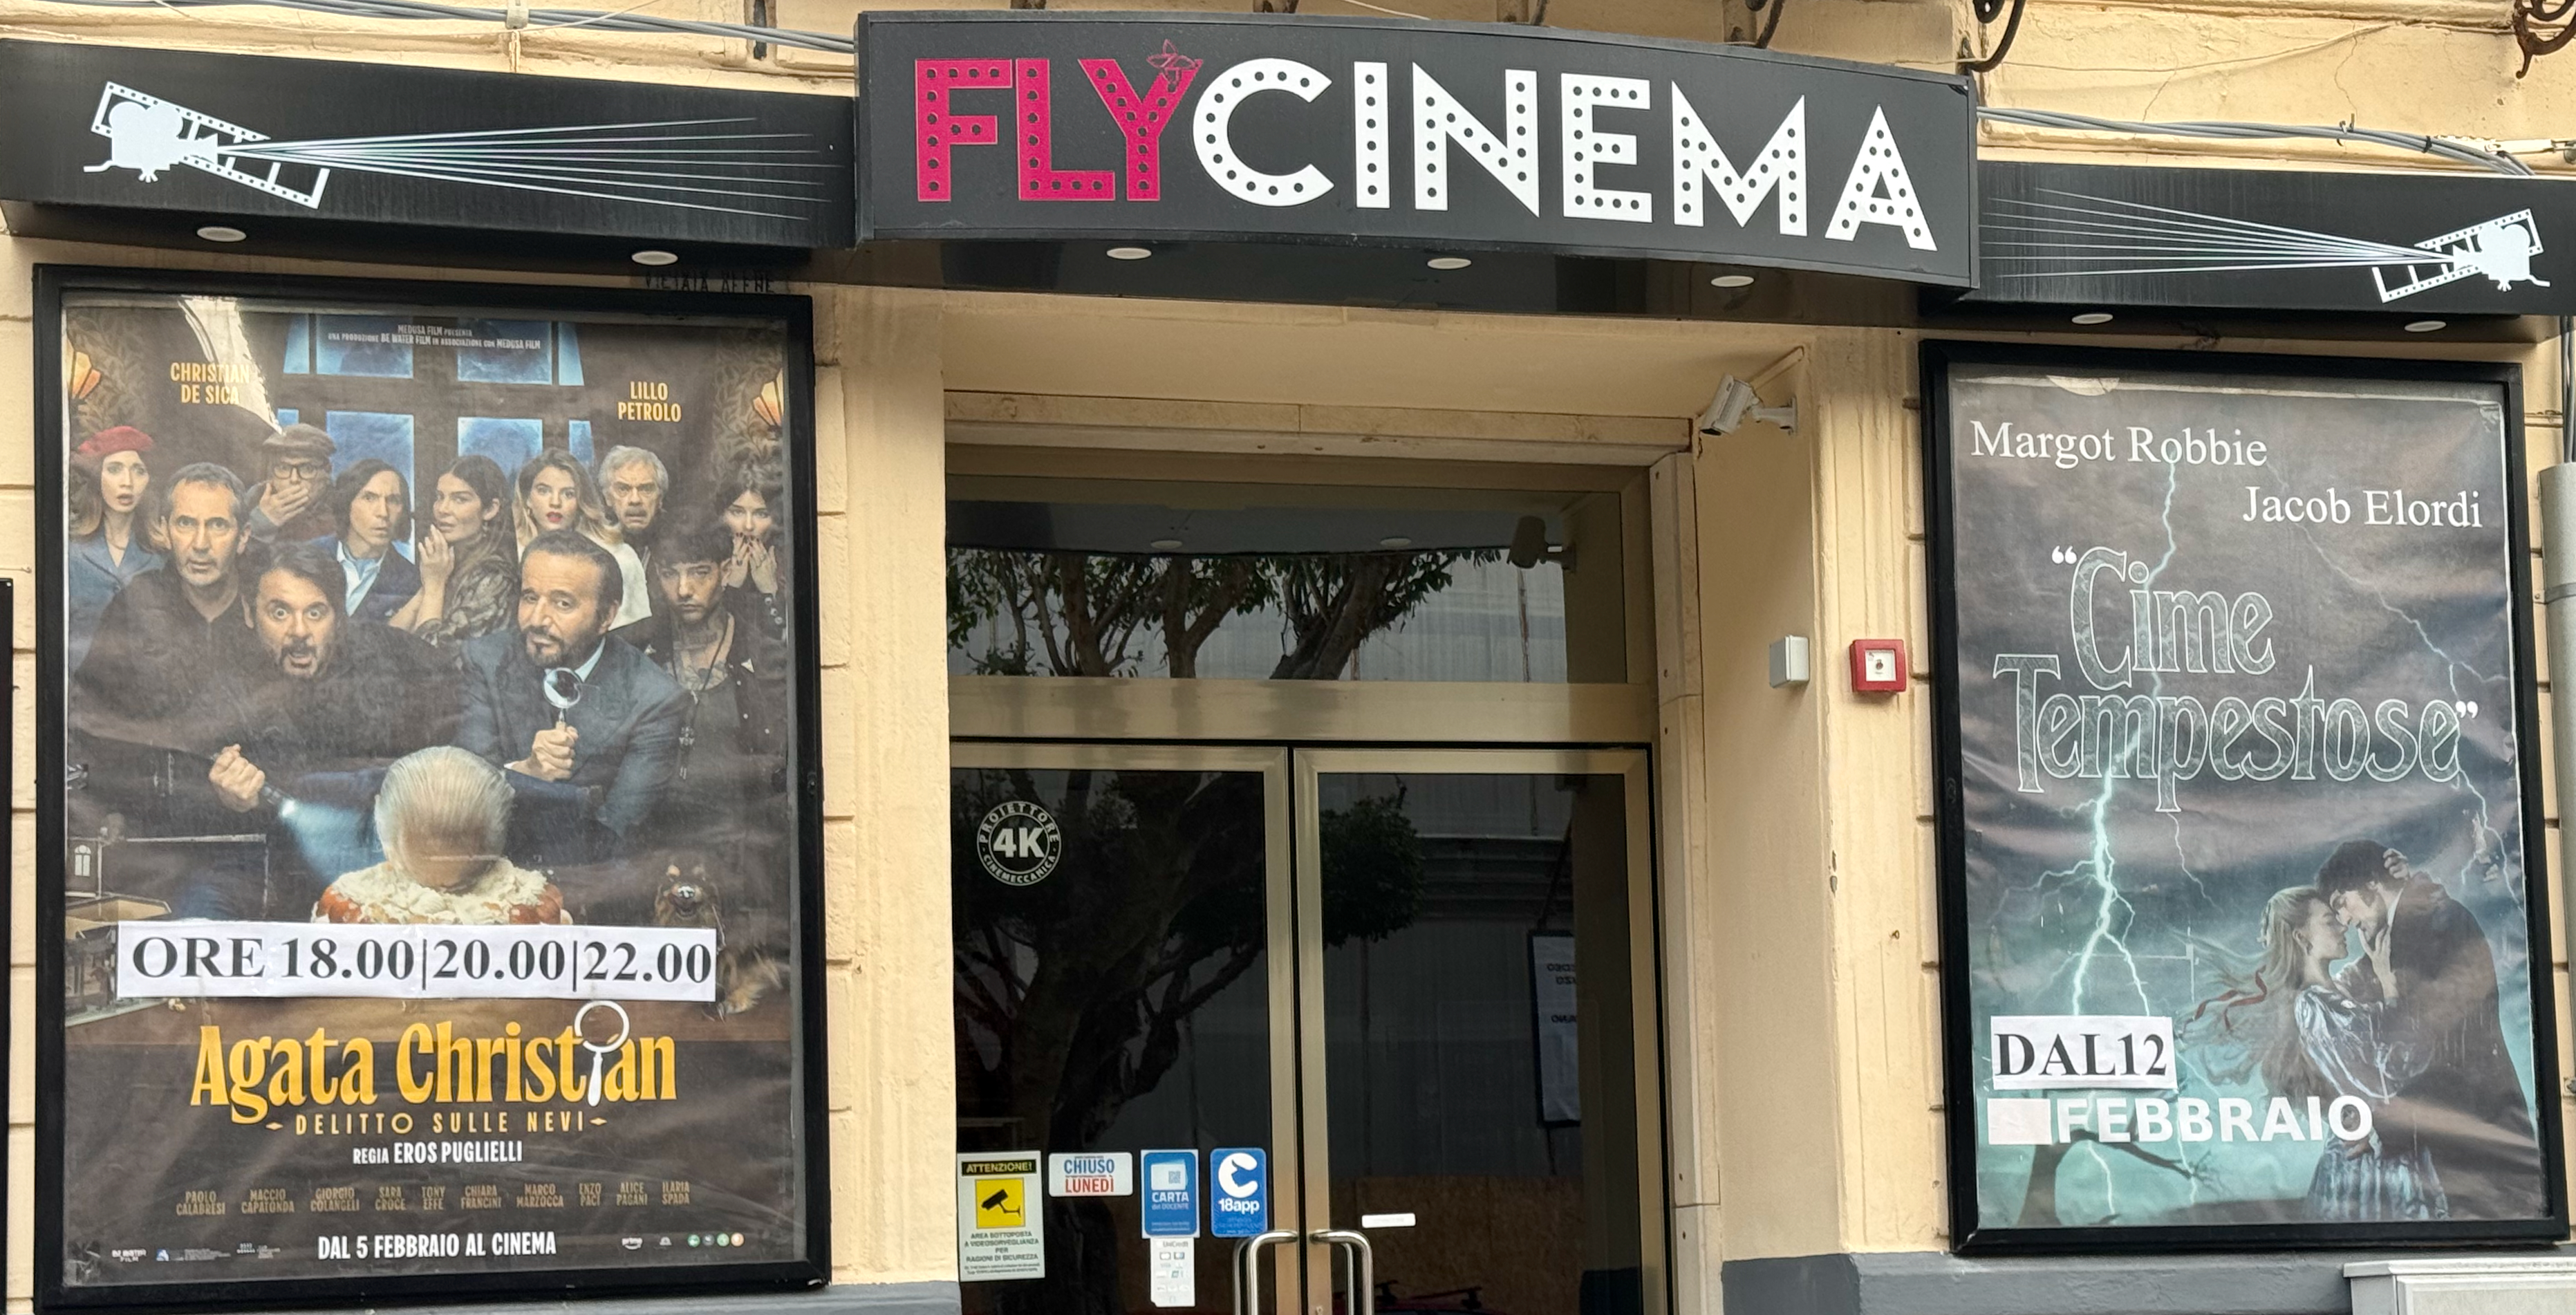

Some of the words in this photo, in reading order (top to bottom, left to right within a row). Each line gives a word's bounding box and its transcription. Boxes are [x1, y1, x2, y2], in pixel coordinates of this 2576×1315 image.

[398, 324, 426, 335] MEDUSA
[427, 326, 442, 336] FILM
[381, 333, 390, 343] BE
[392, 334, 414, 344] WATER
[416, 335, 431, 345] FILM
[496, 339, 524, 349] MEDUSA
[525, 340, 541, 349] FILM
[170, 362, 250, 384] CHRISTIAN
[181, 384, 200, 403] DE
[205, 385, 239, 404] SICA
[630, 381, 669, 400] LILLO
[617, 402, 682, 422] PETROLO
[1970, 421, 2115, 469] Margot
[2127, 427, 2268, 467] Robbie
[2243, 487, 2351, 525] Jacob
[2364, 489, 2483, 528] Elordi
[979, 803, 1059, 843] PROIETTORE
[993, 827, 1045, 858] 4K
[983, 855, 1056, 884] CINEMECCANICA
[132, 936, 265, 980] ORE
[190, 1026, 377, 1124] Agata
[396, 1000, 677, 1107] Christian
[295, 1112, 413, 1135] DELITTO
[433, 1111, 509, 1133] SULLE
[527, 1111, 583, 1132] NEVI
[2058, 1095, 2373, 1144] FEBBRAIO
[353, 1148, 389, 1164] REGIA
[393, 1141, 438, 1164] EROS
[441, 1140, 523, 1163] PUGLIELLI
[966, 1162, 1033, 1173] ATTENZIONE!
[1064, 1158, 1115, 1174] CHIUSO
[524, 1184, 556, 1195] MARCO
[579, 1183, 601, 1195] ENZO
[620, 1182, 644, 1193] ALICE
[662, 1181, 690, 1193] ILARIA
[1065, 1174, 1114, 1193] LUNEDÌ
[185, 1191, 216, 1203] PAOLO
[250, 1188, 286, 1200] MACCIO
[315, 1187, 355, 1200] GIORGIO
[379, 1186, 402, 1198] SARA
[422, 1186, 445, 1197] TONY
[465, 1185, 497, 1197] CHIARA
[1152, 1191, 1189, 1202] CARTA
[310, 1199, 360, 1211] COLANGELI
[375, 1198, 407, 1210] CROCE
[423, 1197, 443, 1210] EFFE
[461, 1197, 501, 1209] FRANCINI
[516, 1195, 564, 1208] MARZOCCA
[580, 1194, 600, 1206] PACI
[617, 1193, 648, 1206] PAGANI
[662, 1193, 690, 1205] SPADA
[176, 1202, 226, 1215] CALABRESI
[241, 1200, 295, 1213] CAPATONDA
[1218, 1197, 1260, 1215] 18app
[318, 1235, 351, 1260] DAL
[356, 1235, 368, 1259] 5
[374, 1233, 460, 1258] FEBBRAIO
[465, 1233, 486, 1256] AL
[492, 1231, 557, 1256] CINEMA
